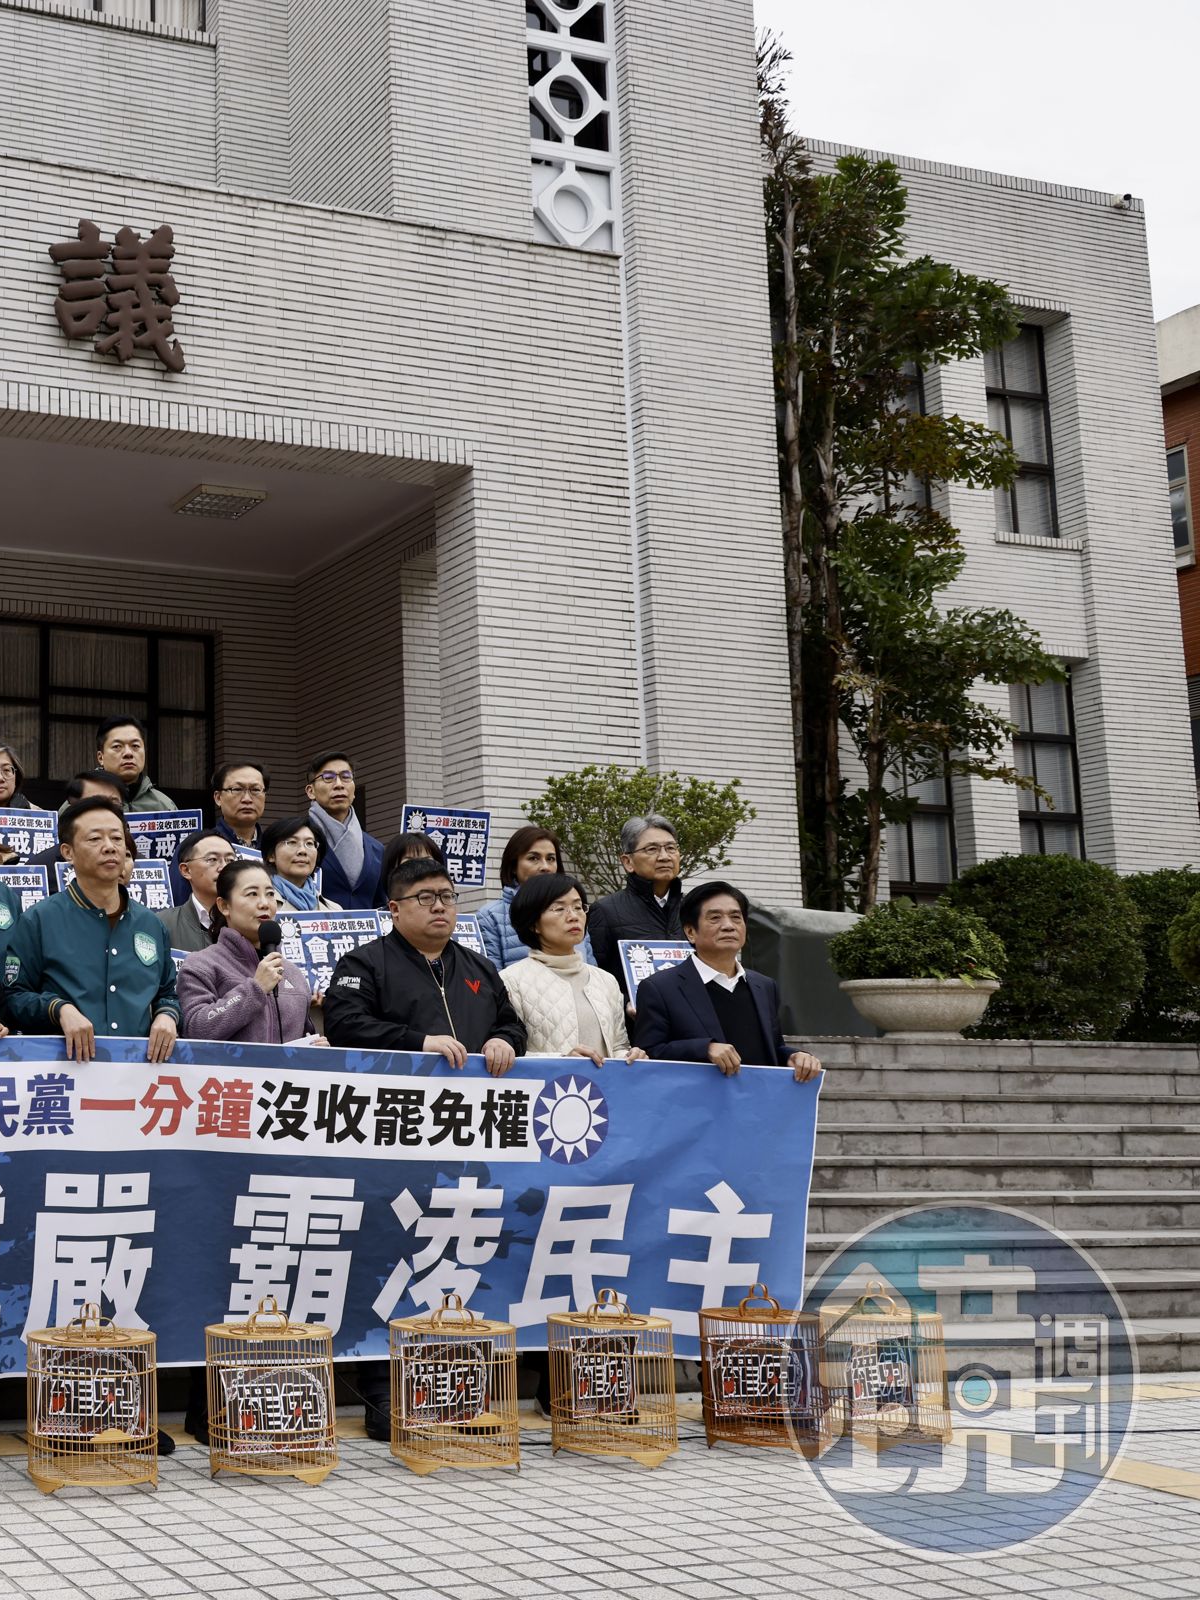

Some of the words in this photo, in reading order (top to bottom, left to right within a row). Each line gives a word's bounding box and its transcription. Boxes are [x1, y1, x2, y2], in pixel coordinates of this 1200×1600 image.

[48, 219, 186, 373] 議
[130, 818, 197, 831] 一分鐘沒收罷免權
[428, 816, 485, 830] 一分鐘沒收罷免權
[134, 833, 191, 859] 會戒
[446, 859, 483, 883] 民主
[302, 919, 375, 932] 一分鐘沒收罷免權
[224, 1174, 773, 1341] 霸凌民主
